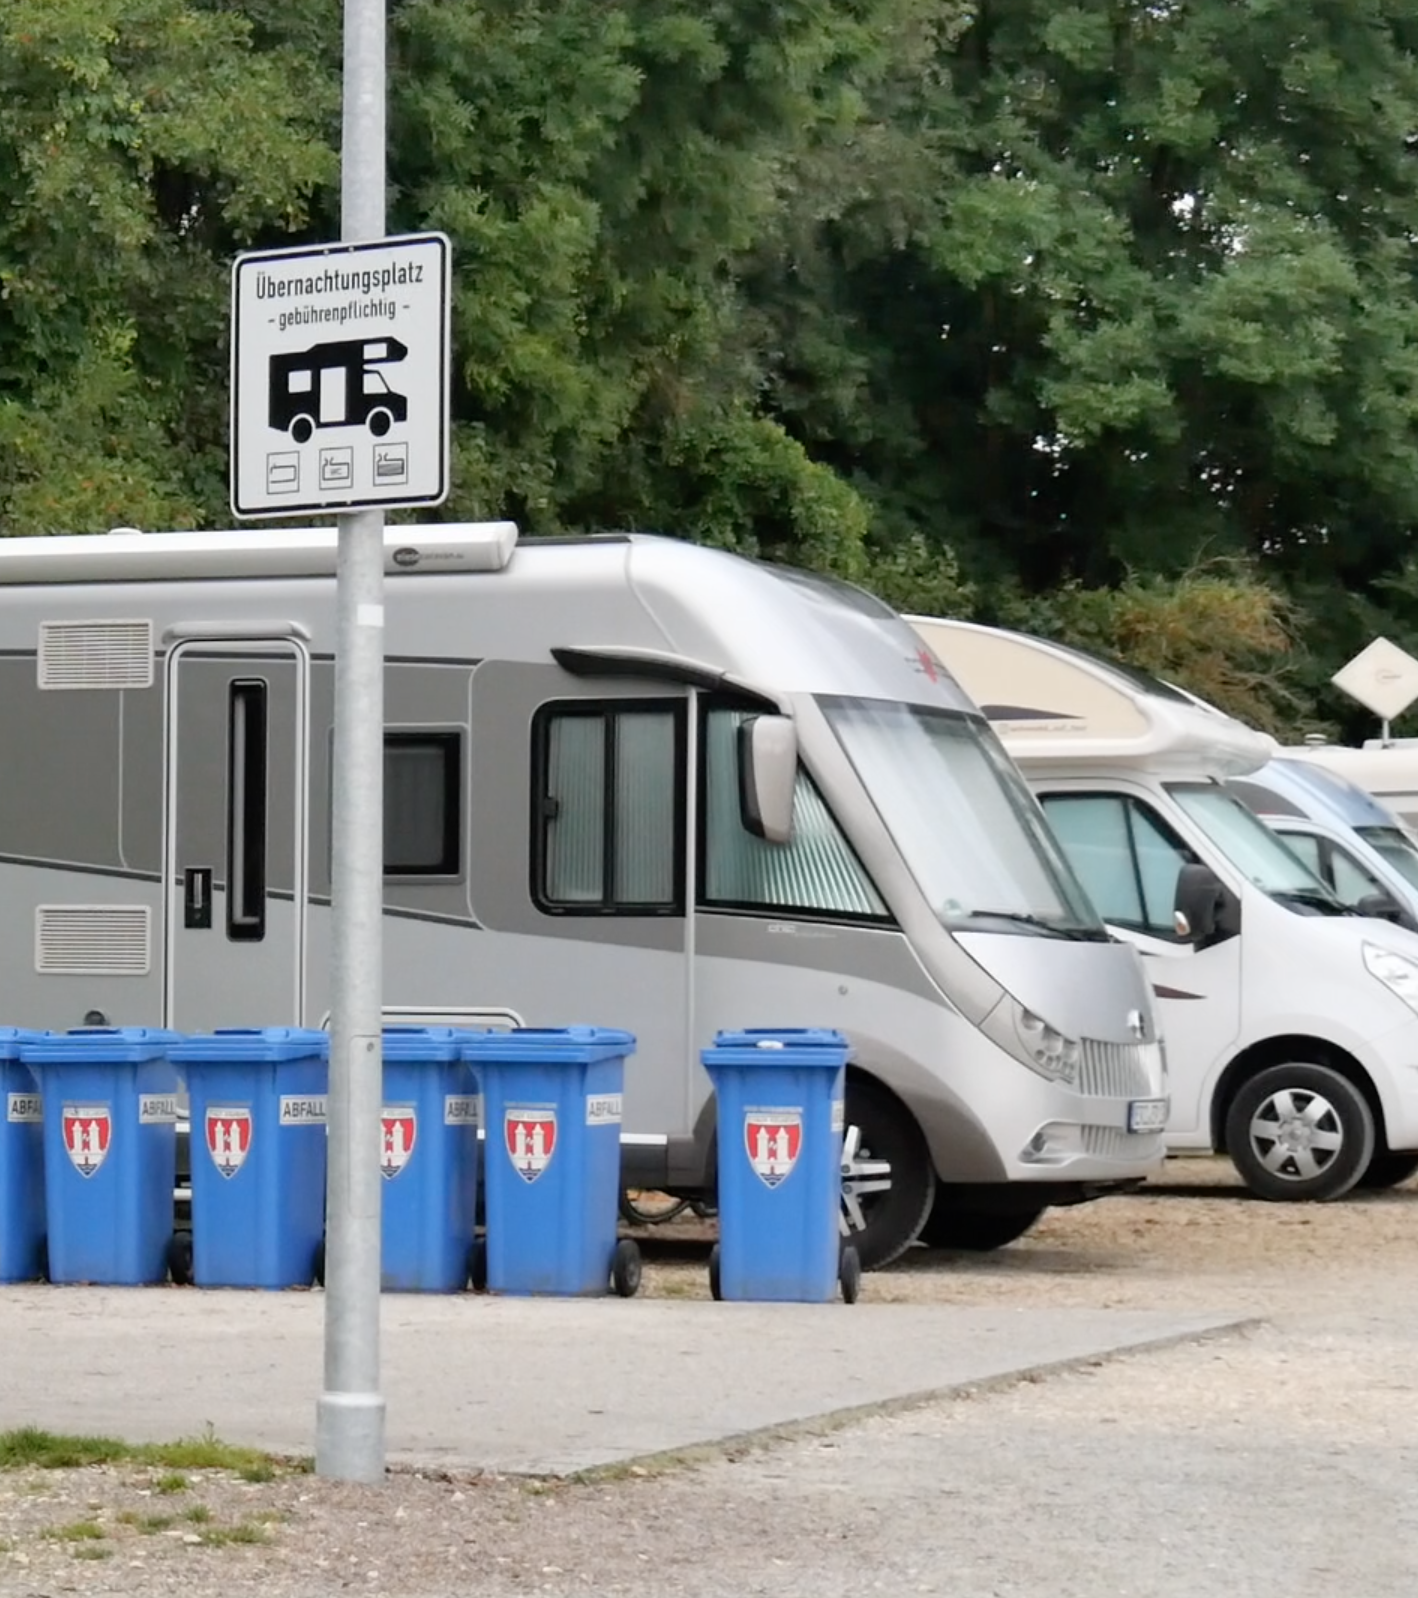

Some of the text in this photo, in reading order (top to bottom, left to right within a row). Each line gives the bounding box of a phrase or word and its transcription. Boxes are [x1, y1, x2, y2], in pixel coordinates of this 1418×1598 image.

[256, 261, 424, 299] Übernachtungsplatz
[279, 299, 396, 331] gebührenpflichtig
[142, 1100, 175, 1116] ABFALL
[283, 1101, 326, 1117] ABFALL
[589, 1100, 621, 1116] ABFALL
